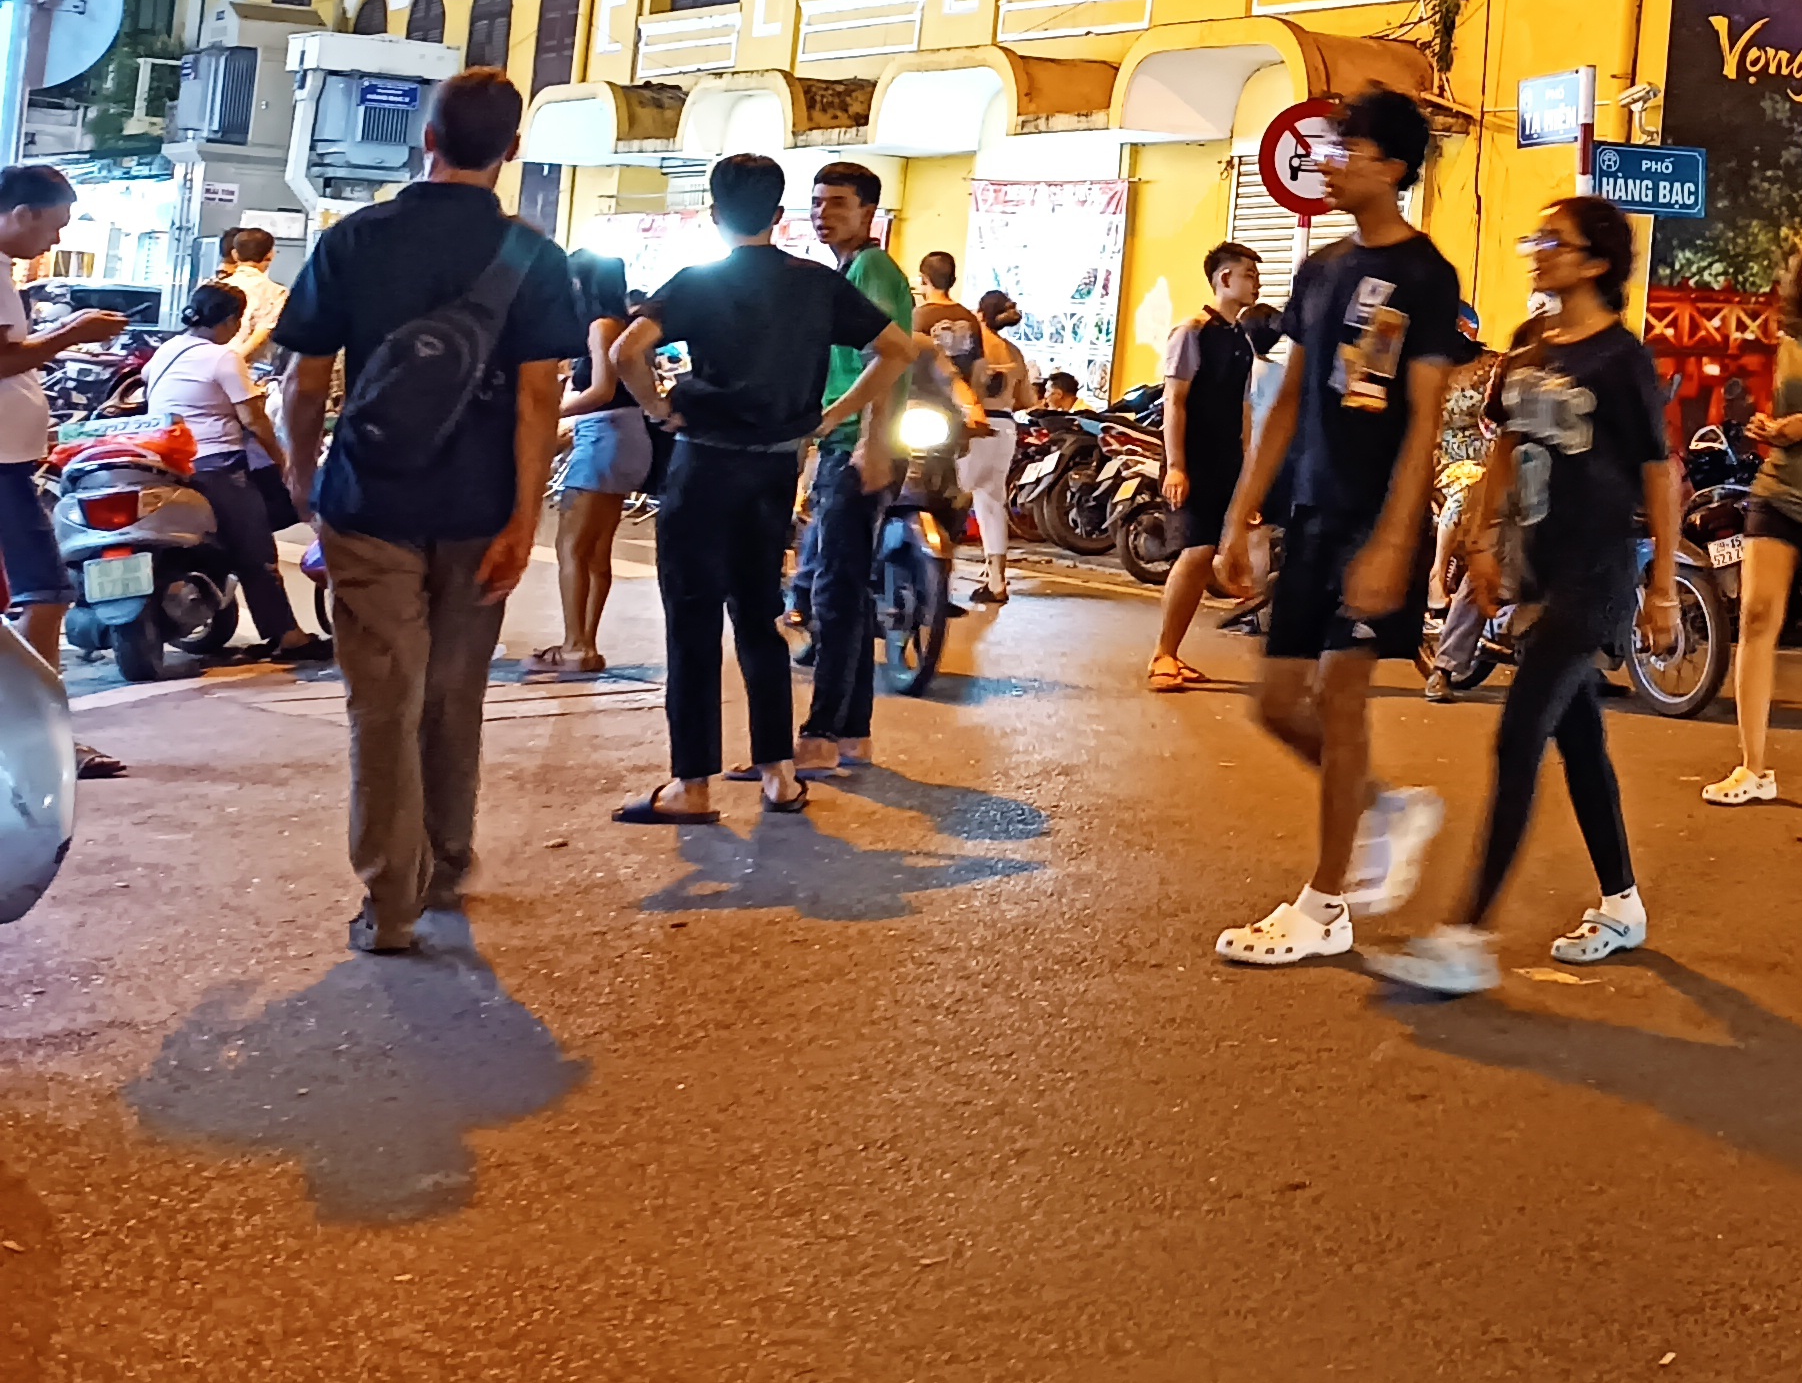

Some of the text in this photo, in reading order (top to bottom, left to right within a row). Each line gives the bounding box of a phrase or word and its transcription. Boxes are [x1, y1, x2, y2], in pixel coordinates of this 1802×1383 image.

[1523, 102, 1577, 139] TẠ HIỆN
[1641, 157, 1675, 174] PHỐ
[1601, 172, 1696, 209] HÀNG BẠC
